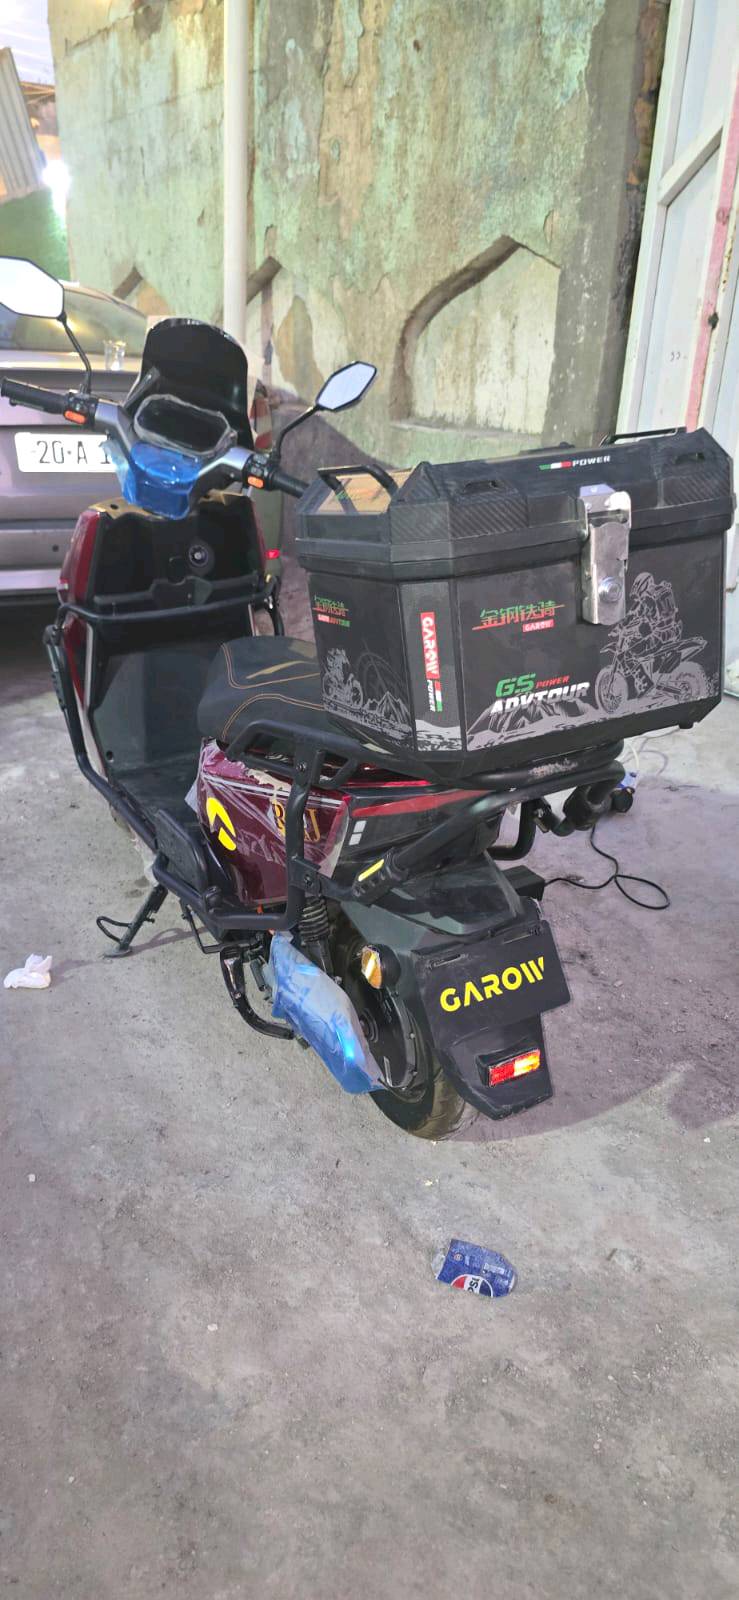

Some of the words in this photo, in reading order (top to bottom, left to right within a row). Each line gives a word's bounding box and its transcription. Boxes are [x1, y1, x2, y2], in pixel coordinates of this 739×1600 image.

[572, 456, 611, 467] POWER
[421, 615, 440, 675] GAROW
[496, 673, 536, 698] GS
[536, 675, 570, 689] POWER
[440, 956, 545, 1012] GAROW
